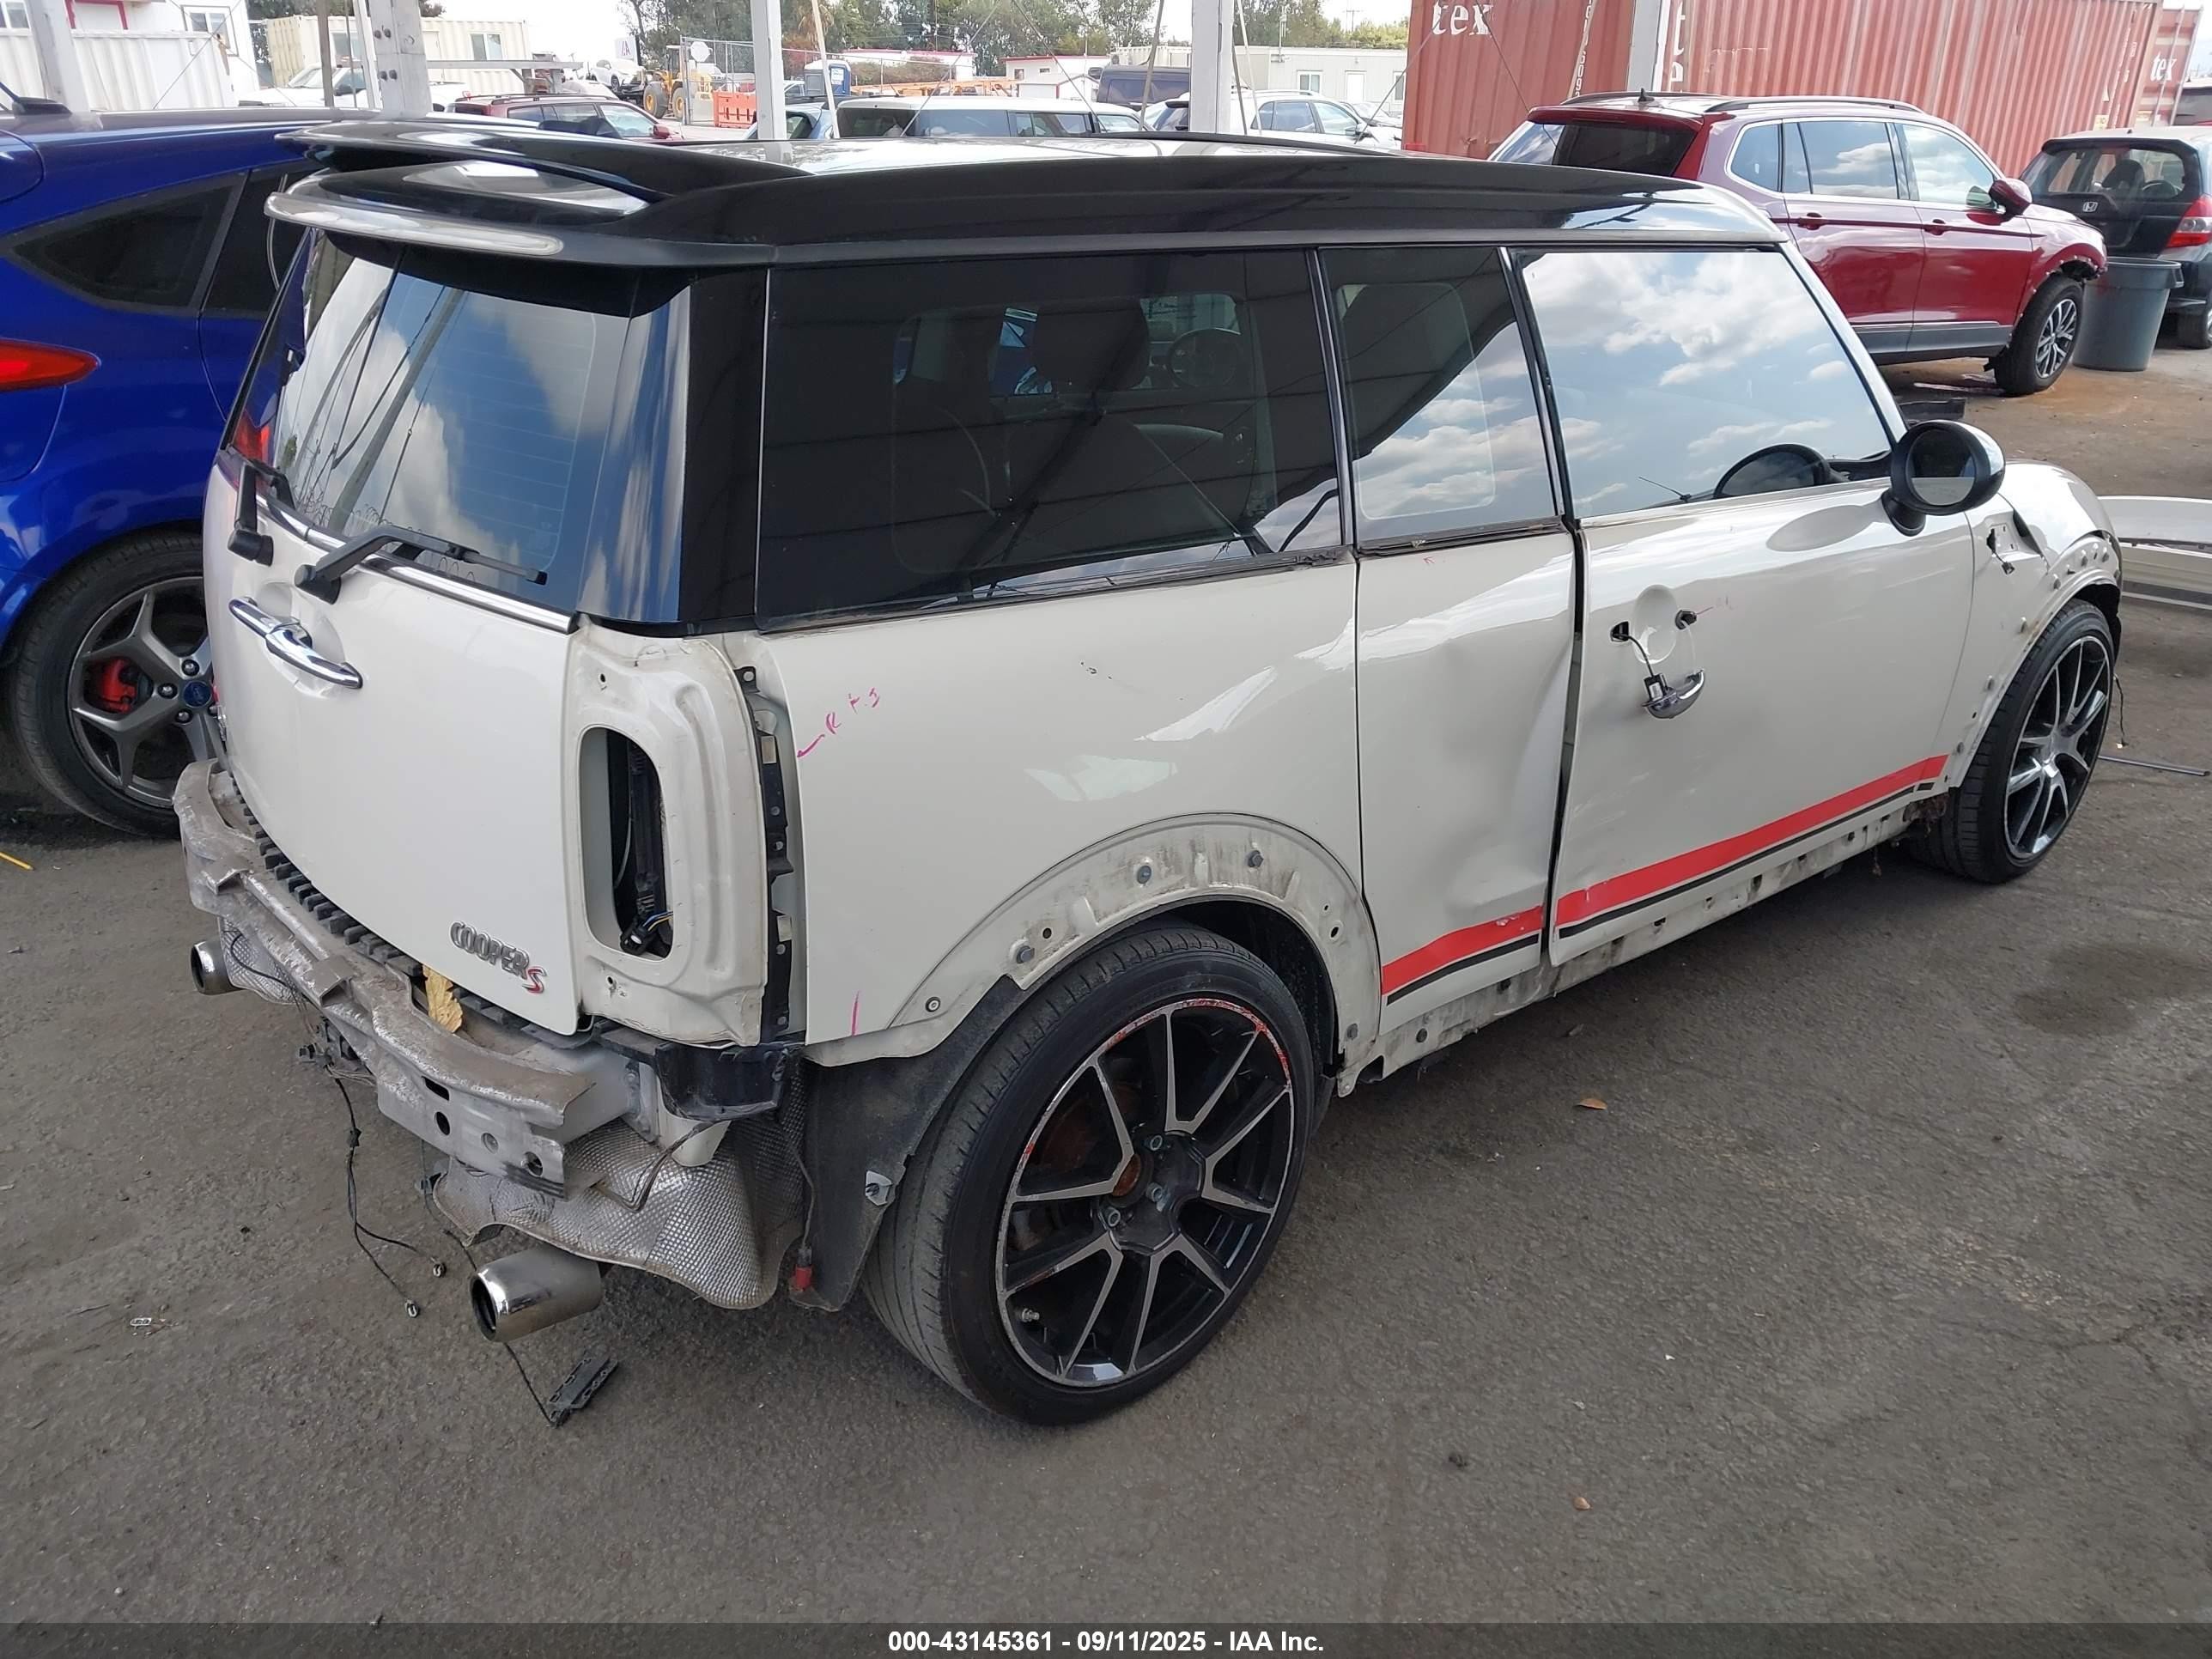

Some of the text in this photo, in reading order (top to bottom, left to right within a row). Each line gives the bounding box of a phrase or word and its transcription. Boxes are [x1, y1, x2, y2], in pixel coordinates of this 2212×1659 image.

[1432, 1, 1494, 35] tex
[2150, 52, 2178, 82] tex
[450, 921, 548, 994] COOPER S
